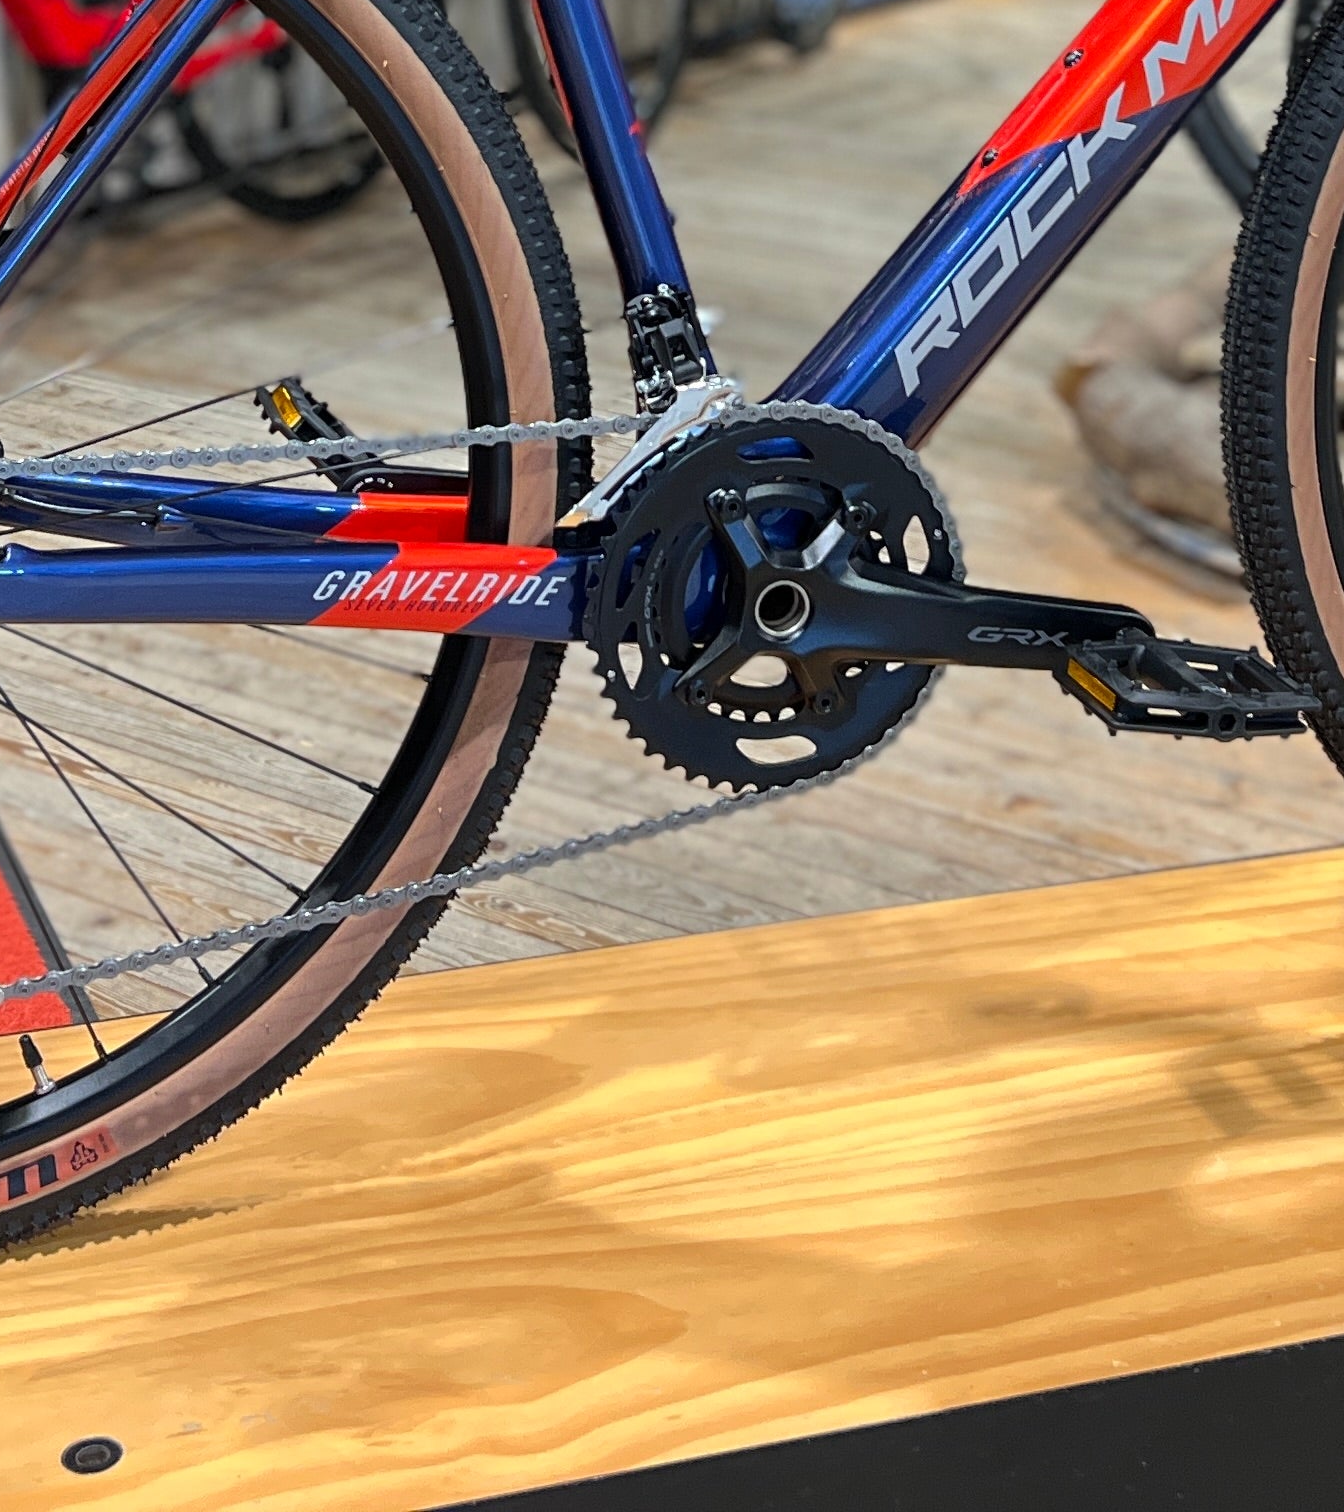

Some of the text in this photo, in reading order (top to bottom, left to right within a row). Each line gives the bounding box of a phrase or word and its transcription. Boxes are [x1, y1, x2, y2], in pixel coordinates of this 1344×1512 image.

[894, 80, 1136, 397] ROCK
[312, 570, 567, 606] GRAVELRIDE
[967, 625, 1069, 648] GRX
